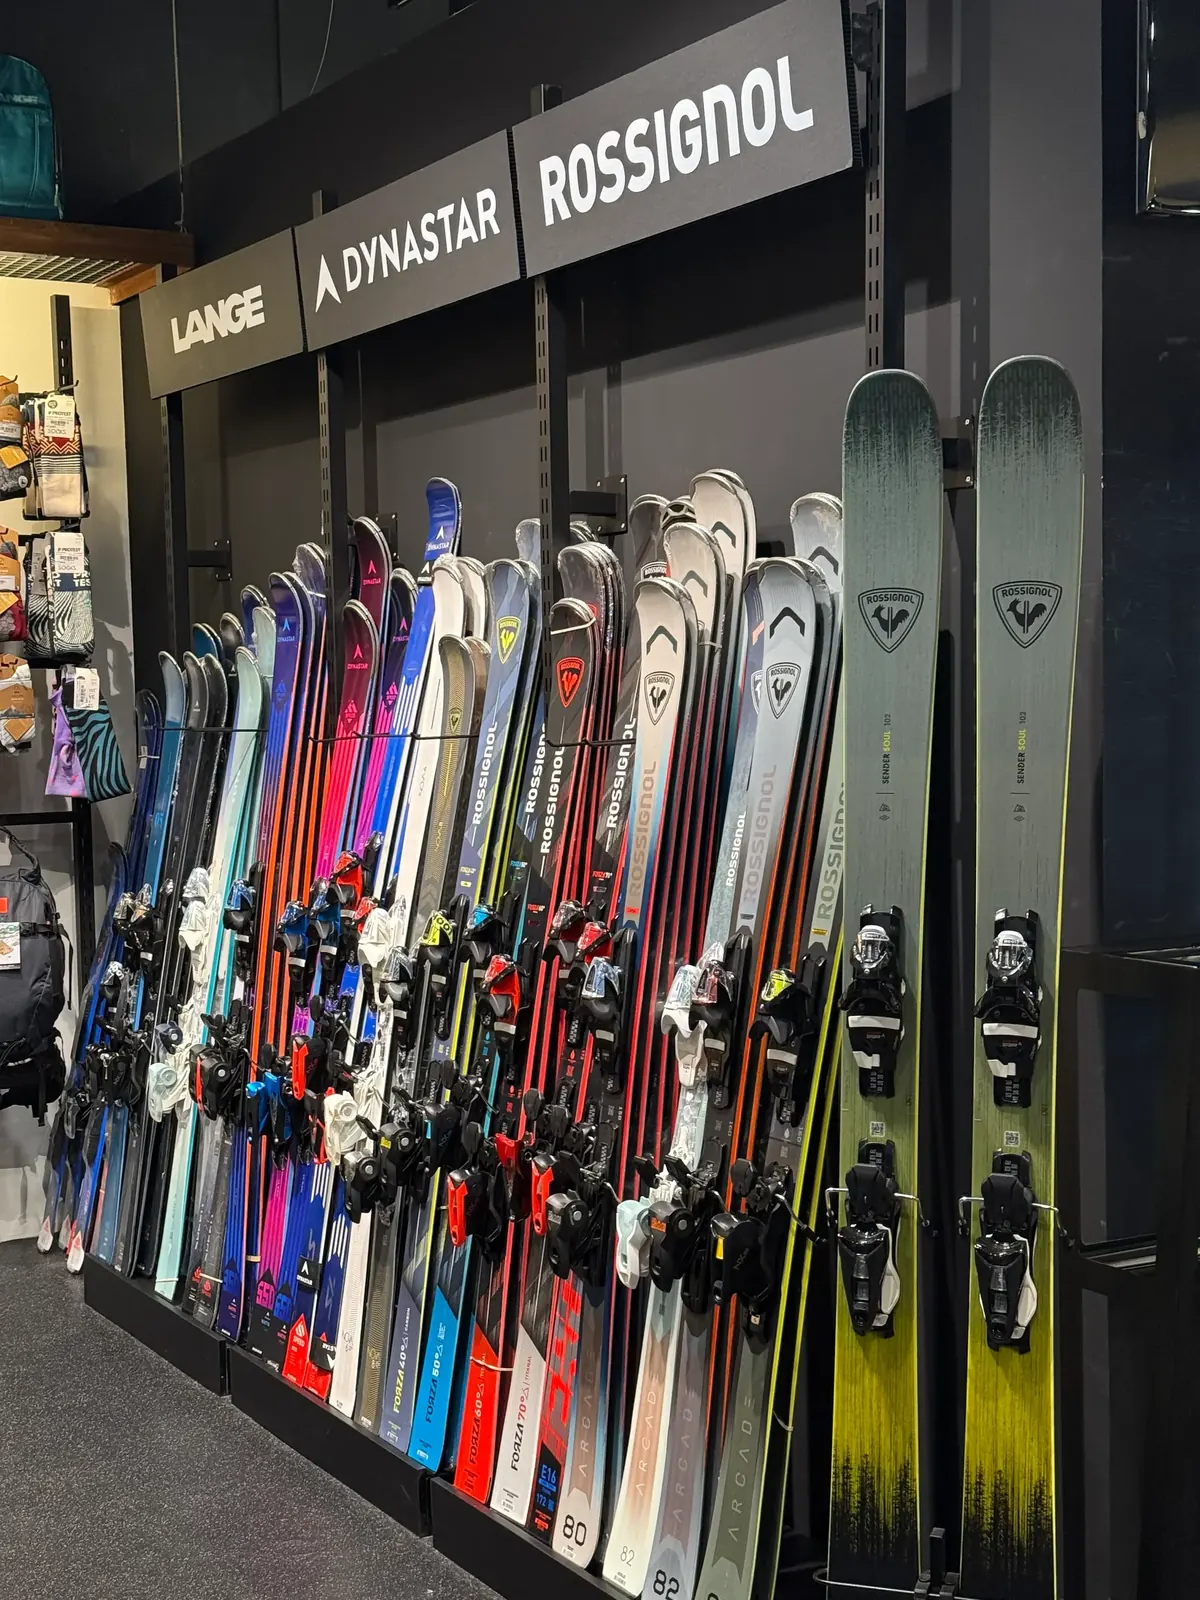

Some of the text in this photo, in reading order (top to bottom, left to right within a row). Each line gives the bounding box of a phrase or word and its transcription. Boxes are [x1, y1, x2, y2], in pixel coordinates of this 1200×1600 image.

[539, 55, 814, 227] ROSSIGNOL
[342, 187, 501, 292] DYNASTAR
[170, 284, 266, 355] LANGE
[866, 593, 915, 604] ROSSIGNOL
[1002, 586, 1053, 598] ROSSIGNOL
[648, 676, 671, 685] ROSSIGNOL
[770, 664, 796, 677] ROSSIGNOL
[883, 730, 891, 752] SOUL
[1016, 711, 1027, 784] SENDER SOUL 102
[472, 721, 498, 825] ROSSIGNOL
[606, 718, 637, 828] ROSSIGNOL
[882, 753, 890, 784] SENDER
[540, 746, 565, 854] ROSSIGNOL
[630, 761, 657, 898] ROSSIGNOL
[726, 810, 747, 888] ROSSIGNOL
[744, 764, 778, 903] ROSSIGNOL
[393, 1369, 405, 1414] FORZA
[425, 1378, 438, 1424] FORZA
[469, 1415, 482, 1464] FORZA
[510, 1422, 524, 1472] FORZA
[636, 1372, 660, 1497] ARCADE
[673, 1388, 696, 1523] ARCADE
[541, 1464, 556, 1484] E16
[728, 1396, 756, 1542] ARCADE
[562, 1514, 587, 1547] 80
[620, 1545, 635, 1567] 82
[653, 1569, 680, 1600] 82
